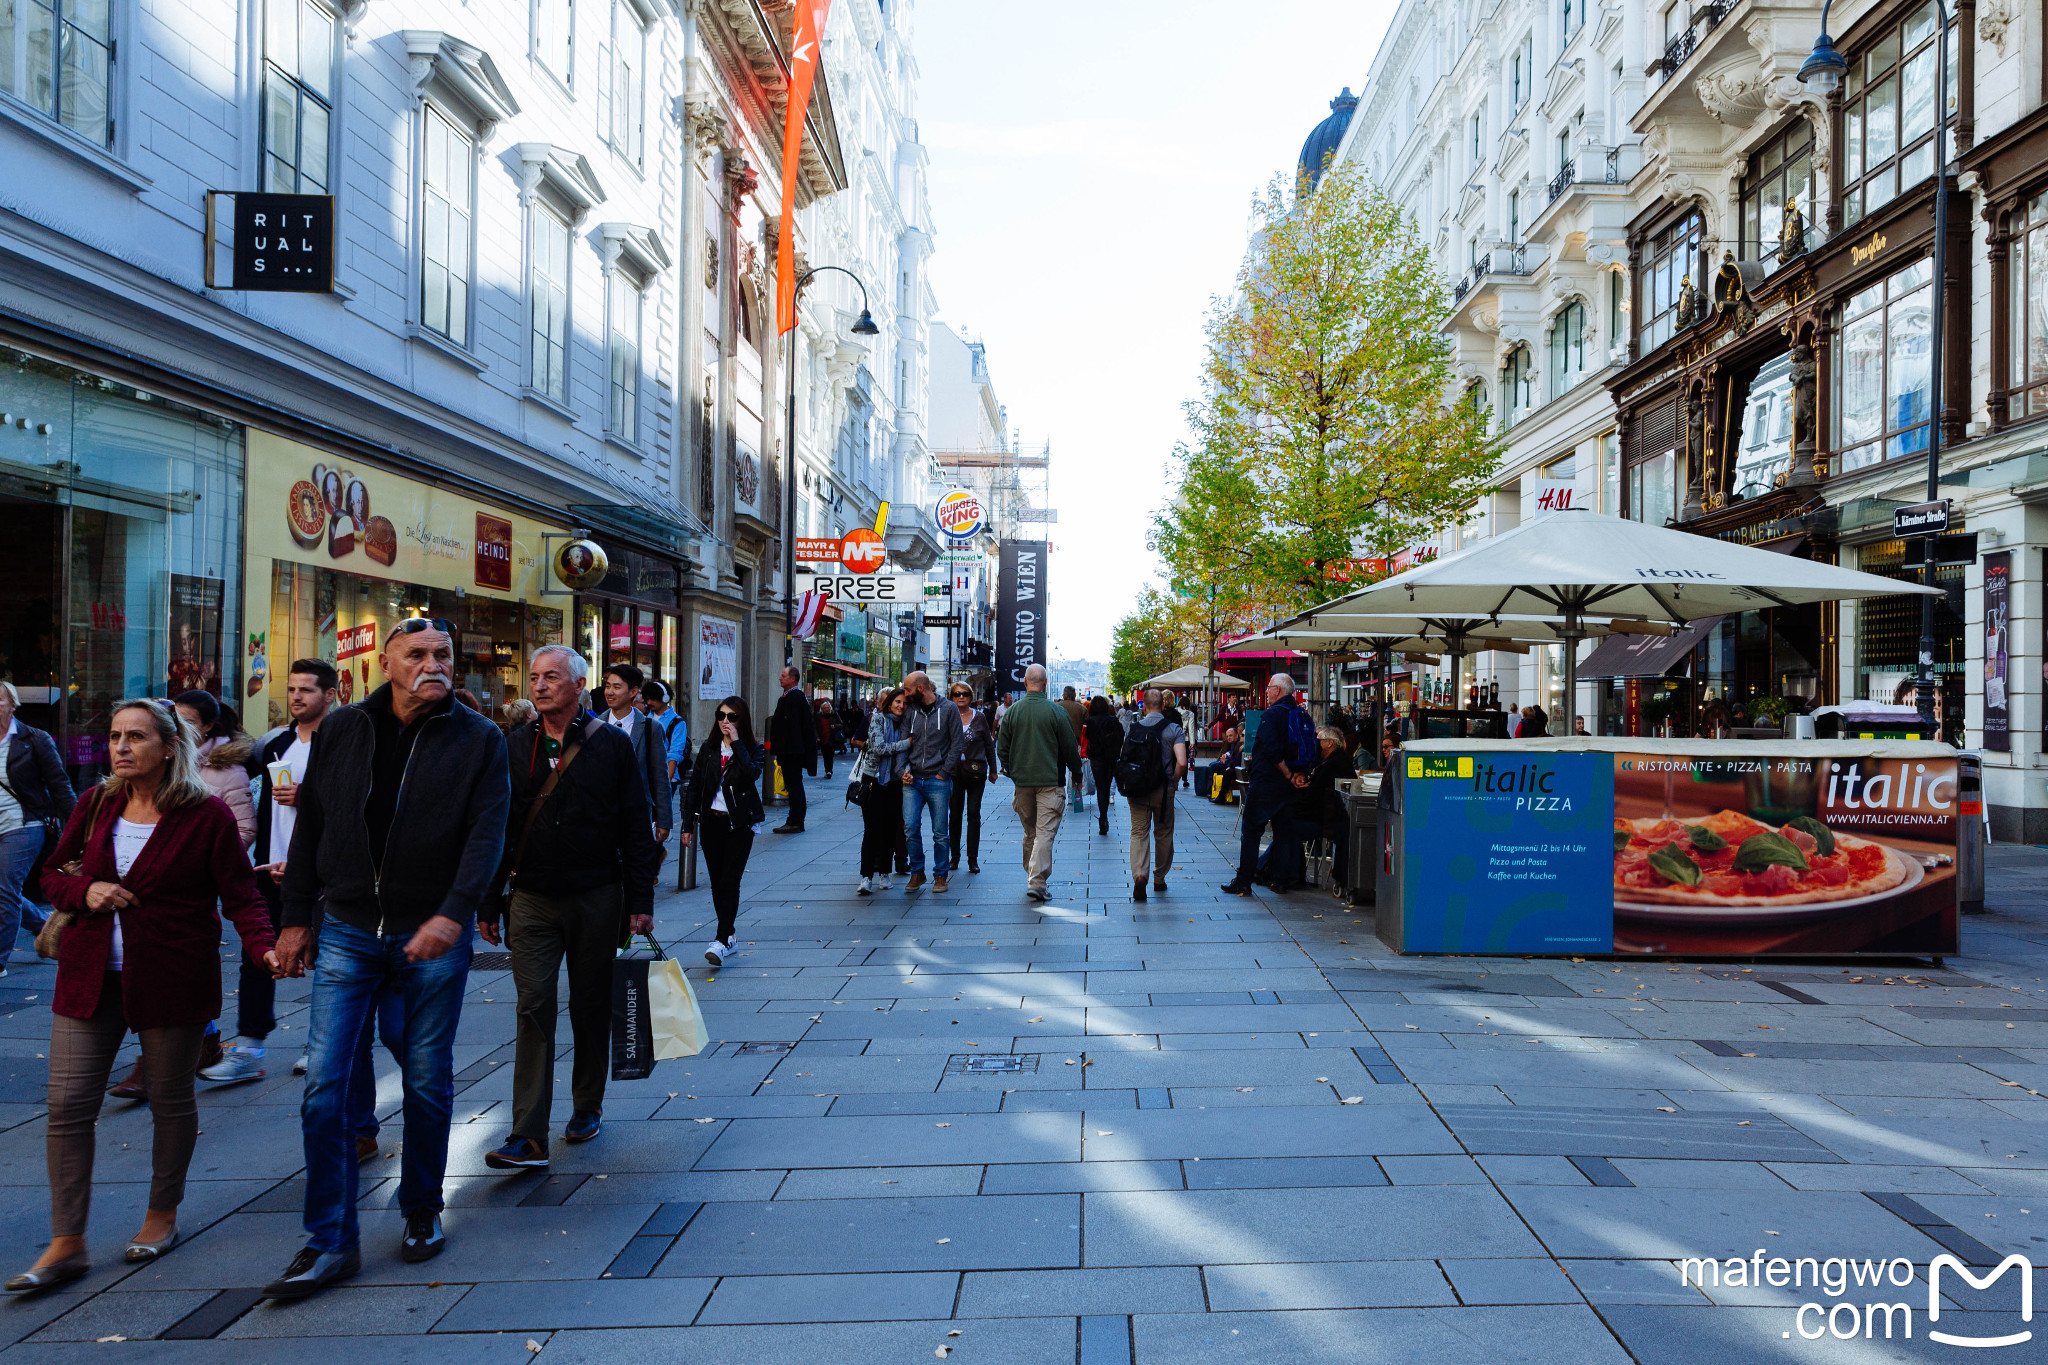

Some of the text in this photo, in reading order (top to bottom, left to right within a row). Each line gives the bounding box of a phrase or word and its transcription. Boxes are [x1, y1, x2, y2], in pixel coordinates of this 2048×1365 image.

[255, 213, 313, 229] RIT
[254, 237, 313, 251] UAL
[1851, 232, 1887, 266] Douglas
[940, 498, 978, 516] BURGER
[1537, 488, 1573, 511] H&M
[941, 506, 980, 529] KING
[1901, 514, 1927, 527] Kärntner
[1926, 509, 1946, 523] Straße
[477, 540, 510, 561] HEINDL
[796, 550, 839, 559] FESSLER
[797, 541, 827, 550] MAYR
[842, 541, 886, 561] MF
[1016, 550, 1037, 602] WIEN
[1634, 567, 1727, 580] italic
[814, 577, 896, 600] BREE
[355, 627, 374, 650] offer
[1424, 768, 1456, 778] Sturm
[1637, 760, 1813, 773] RISTORANTE PIZZA PASTA
[1474, 763, 1556, 794] italic
[1826, 763, 1953, 810] italic
[1515, 797, 1573, 811] PIZZA
[1826, 813, 1950, 825] WWW.ITALICVIENNA.AT
[1490, 843, 1587, 854] Mittagsmenü 12 bis 14 Uhr
[1489, 857, 1547, 866] Pizza und Pasta
[1487, 871, 1557, 881] Kaffee und Kuchen
[626, 987, 637, 1060] SALAMANDER
